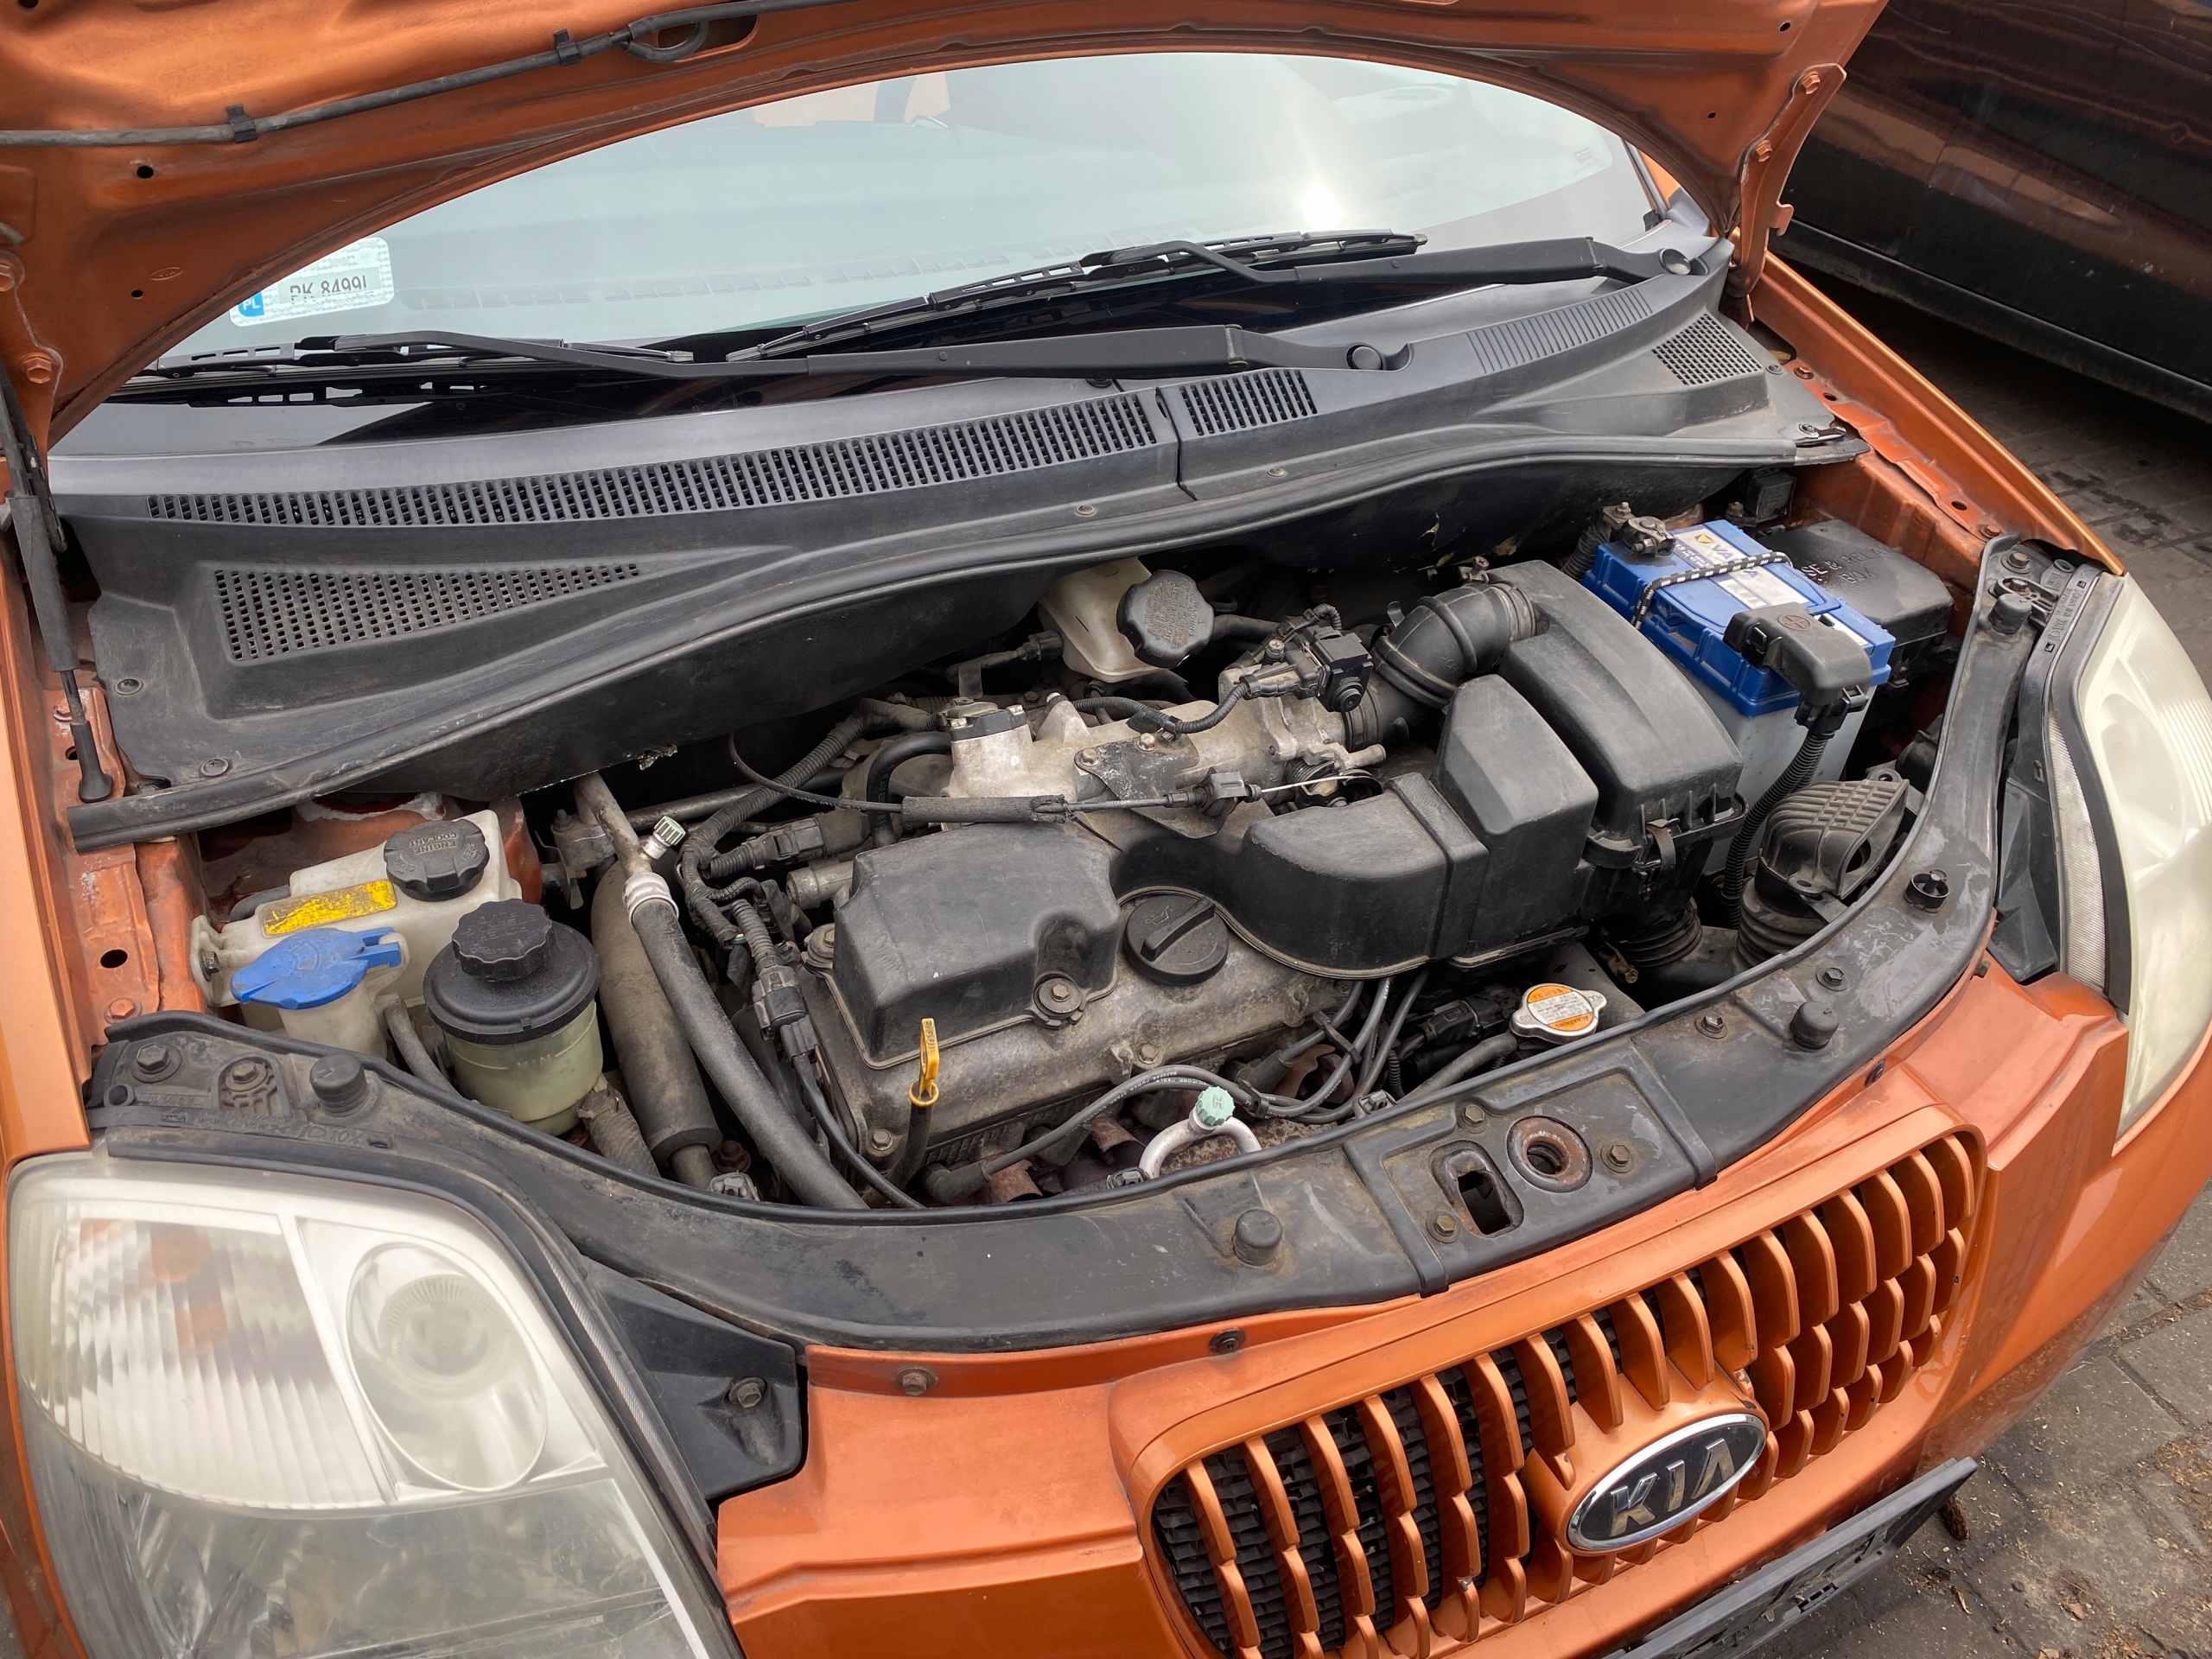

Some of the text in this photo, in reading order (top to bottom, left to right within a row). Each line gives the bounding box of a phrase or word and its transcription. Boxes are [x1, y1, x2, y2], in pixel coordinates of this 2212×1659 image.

[243, 299, 261, 311] PL
[1713, 543, 1759, 578] VAA
[1840, 544, 1891, 564] RELAY
[1840, 568, 1878, 583] BOX
[410, 832, 458, 848] COOLANT
[415, 840, 456, 855] ENGINE
[1554, 1017, 1584, 1028] WARNING
[1609, 1437, 1736, 1537] KIA
